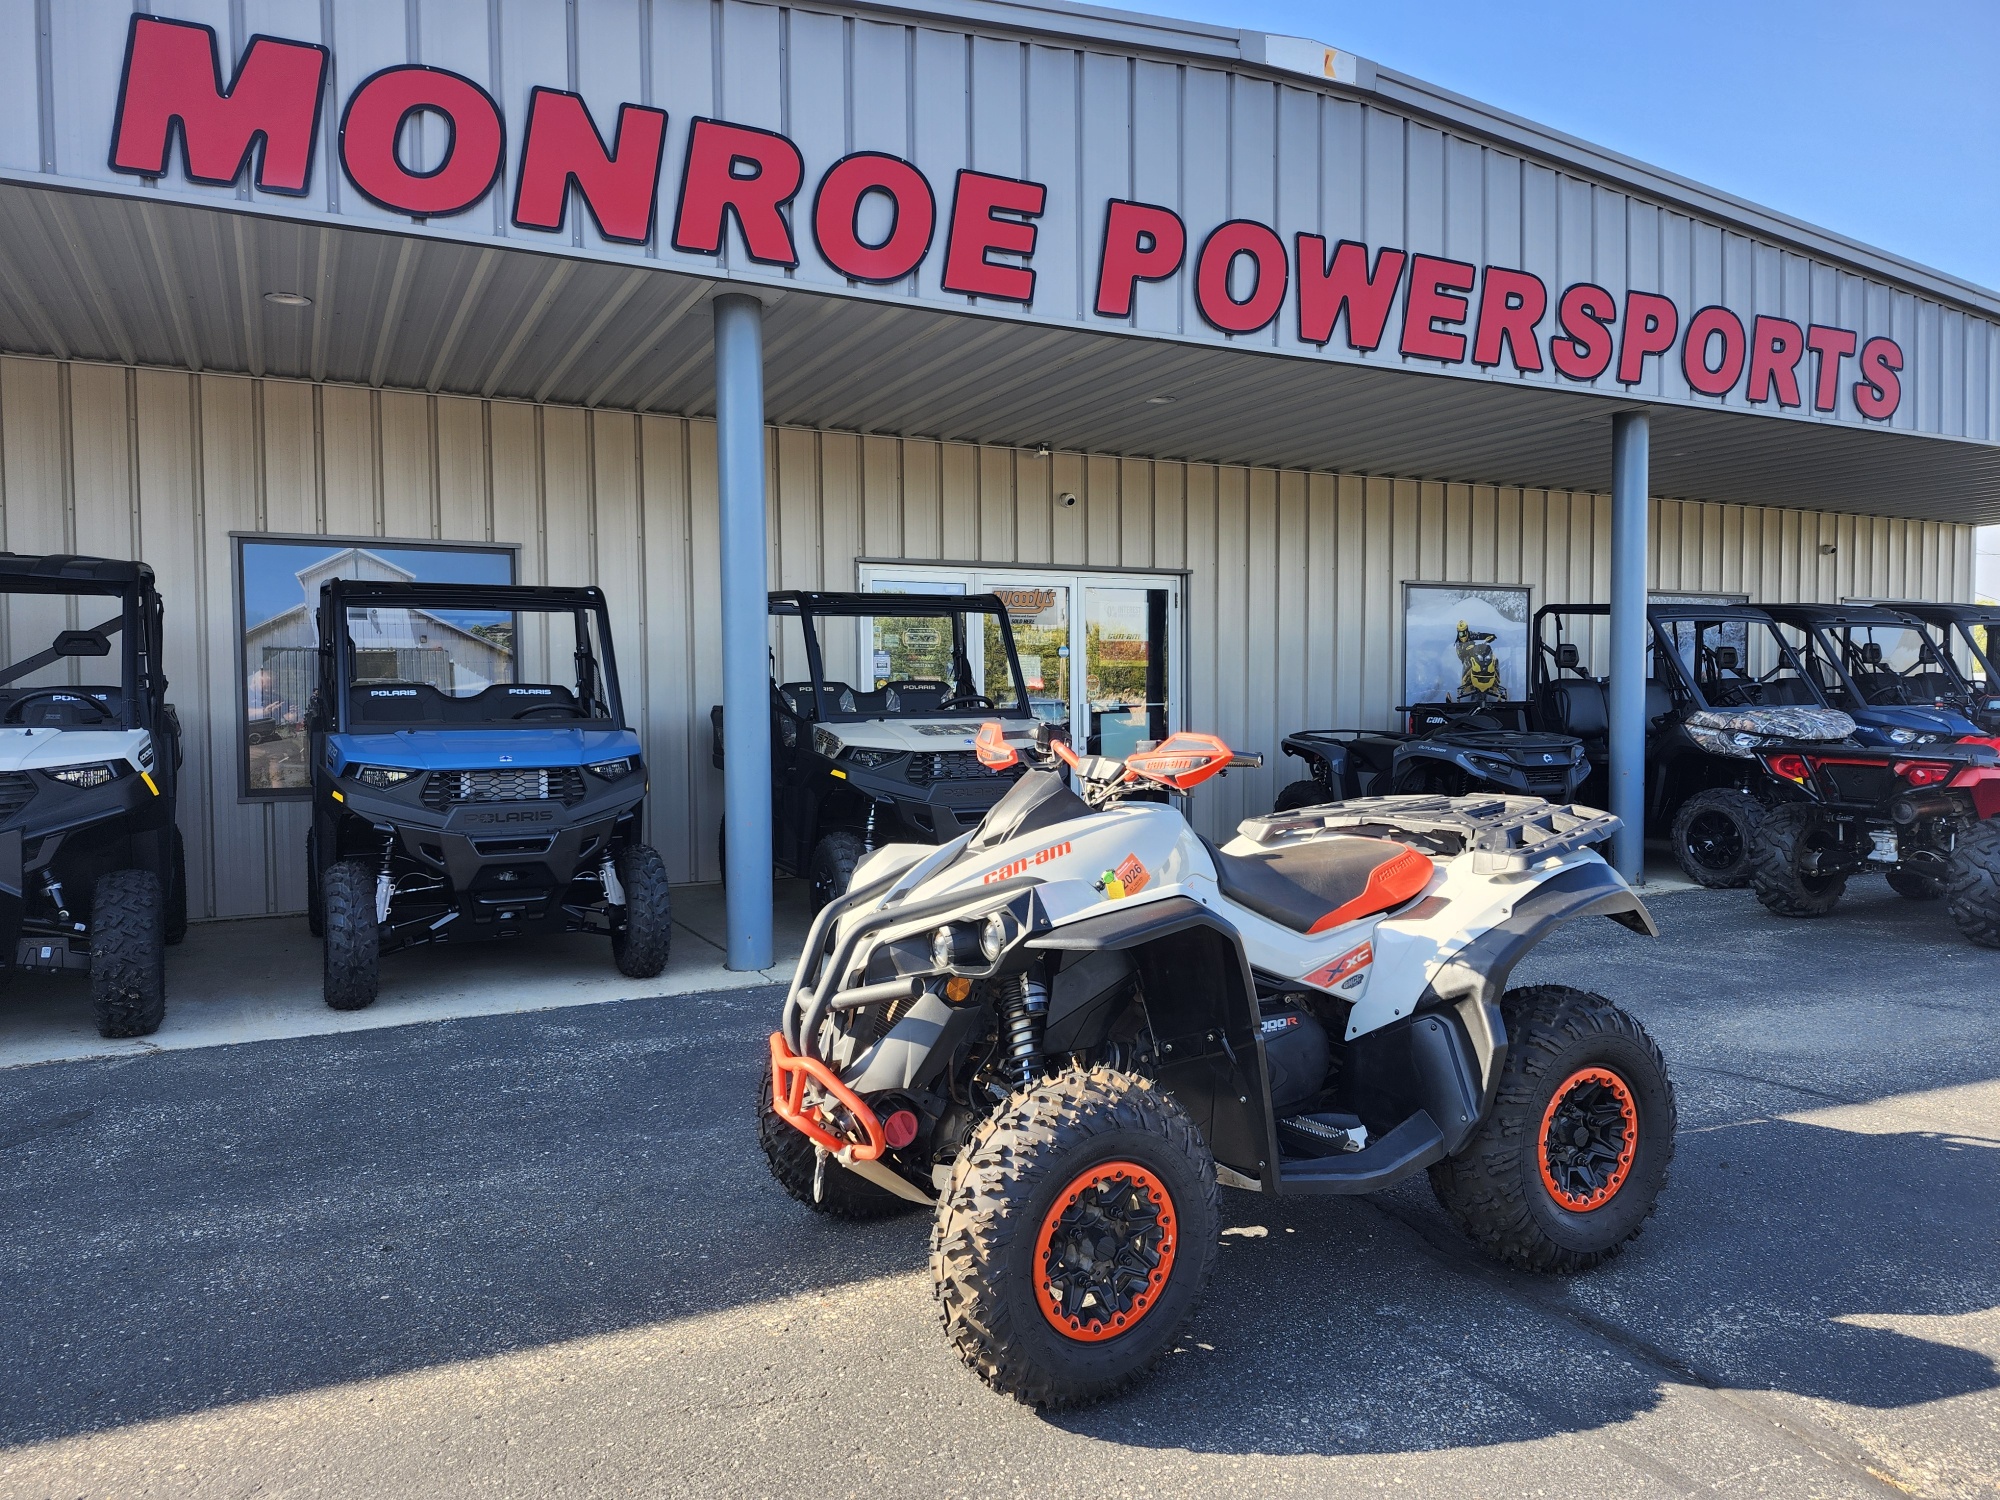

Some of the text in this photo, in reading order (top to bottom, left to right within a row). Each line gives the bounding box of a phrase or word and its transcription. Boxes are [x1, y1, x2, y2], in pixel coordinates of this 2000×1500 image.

[108, 12, 1904, 421] MONROE POWERSPORTS
[370, 689, 418, 697] POLARIS
[817, 733, 834, 746] 570
[1145, 759, 1193, 770] can-am
[464, 810, 554, 824] POLARIS
[984, 841, 1072, 885] can-am
[1377, 855, 1417, 883] can-am
[1121, 863, 1142, 891] 2026
